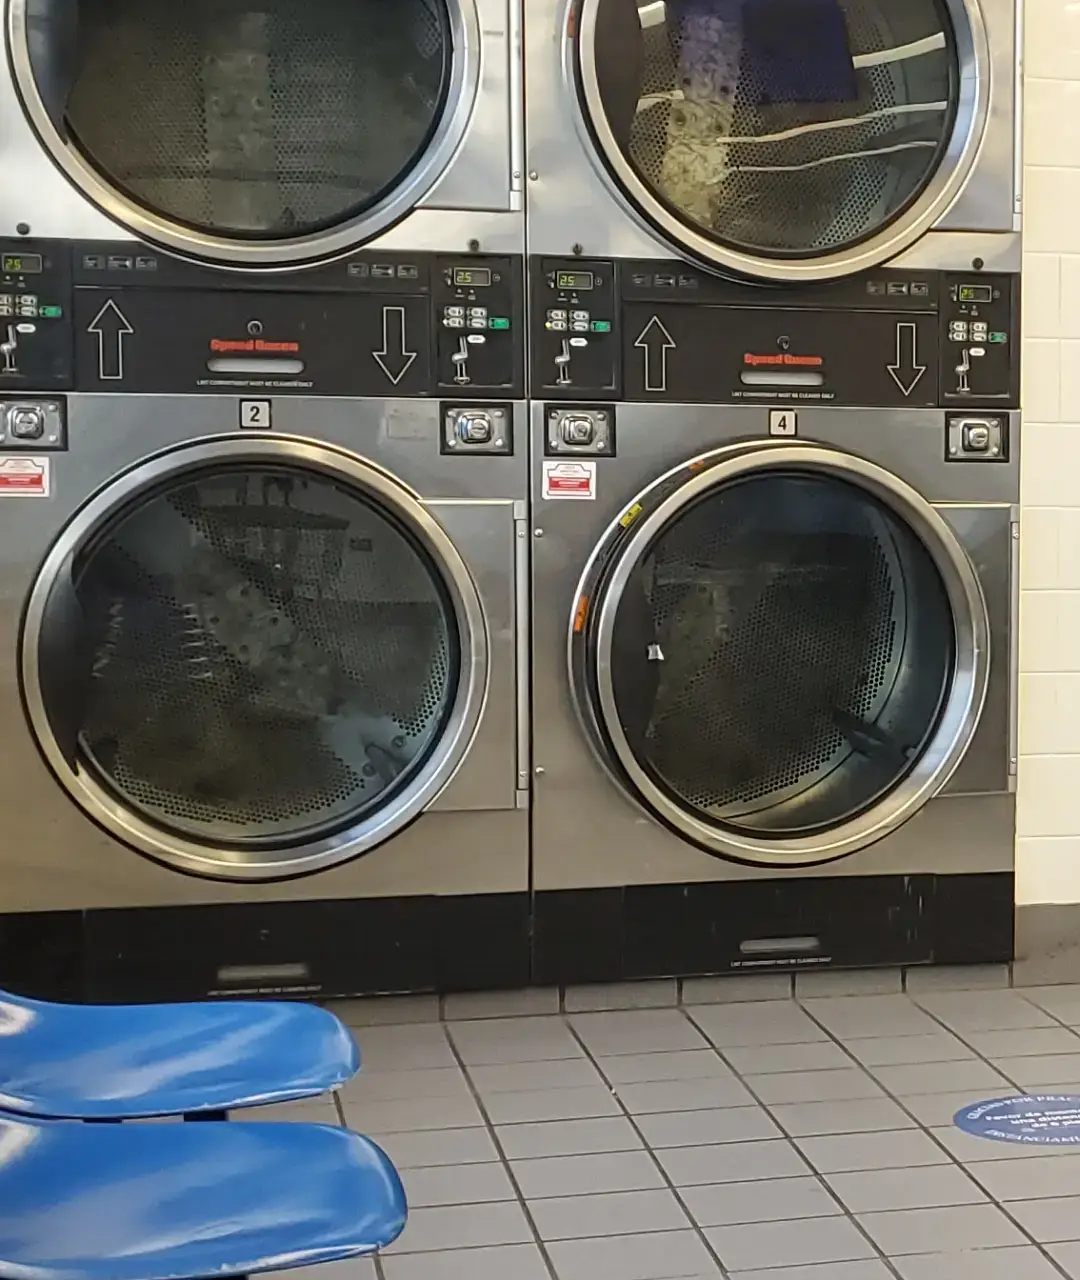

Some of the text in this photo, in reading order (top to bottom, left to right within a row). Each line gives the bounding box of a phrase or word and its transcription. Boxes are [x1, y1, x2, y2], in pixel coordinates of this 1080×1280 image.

[559, 275, 575, 286] 25
[249, 405, 260, 422] 2
[777, 415, 787, 431] 4
